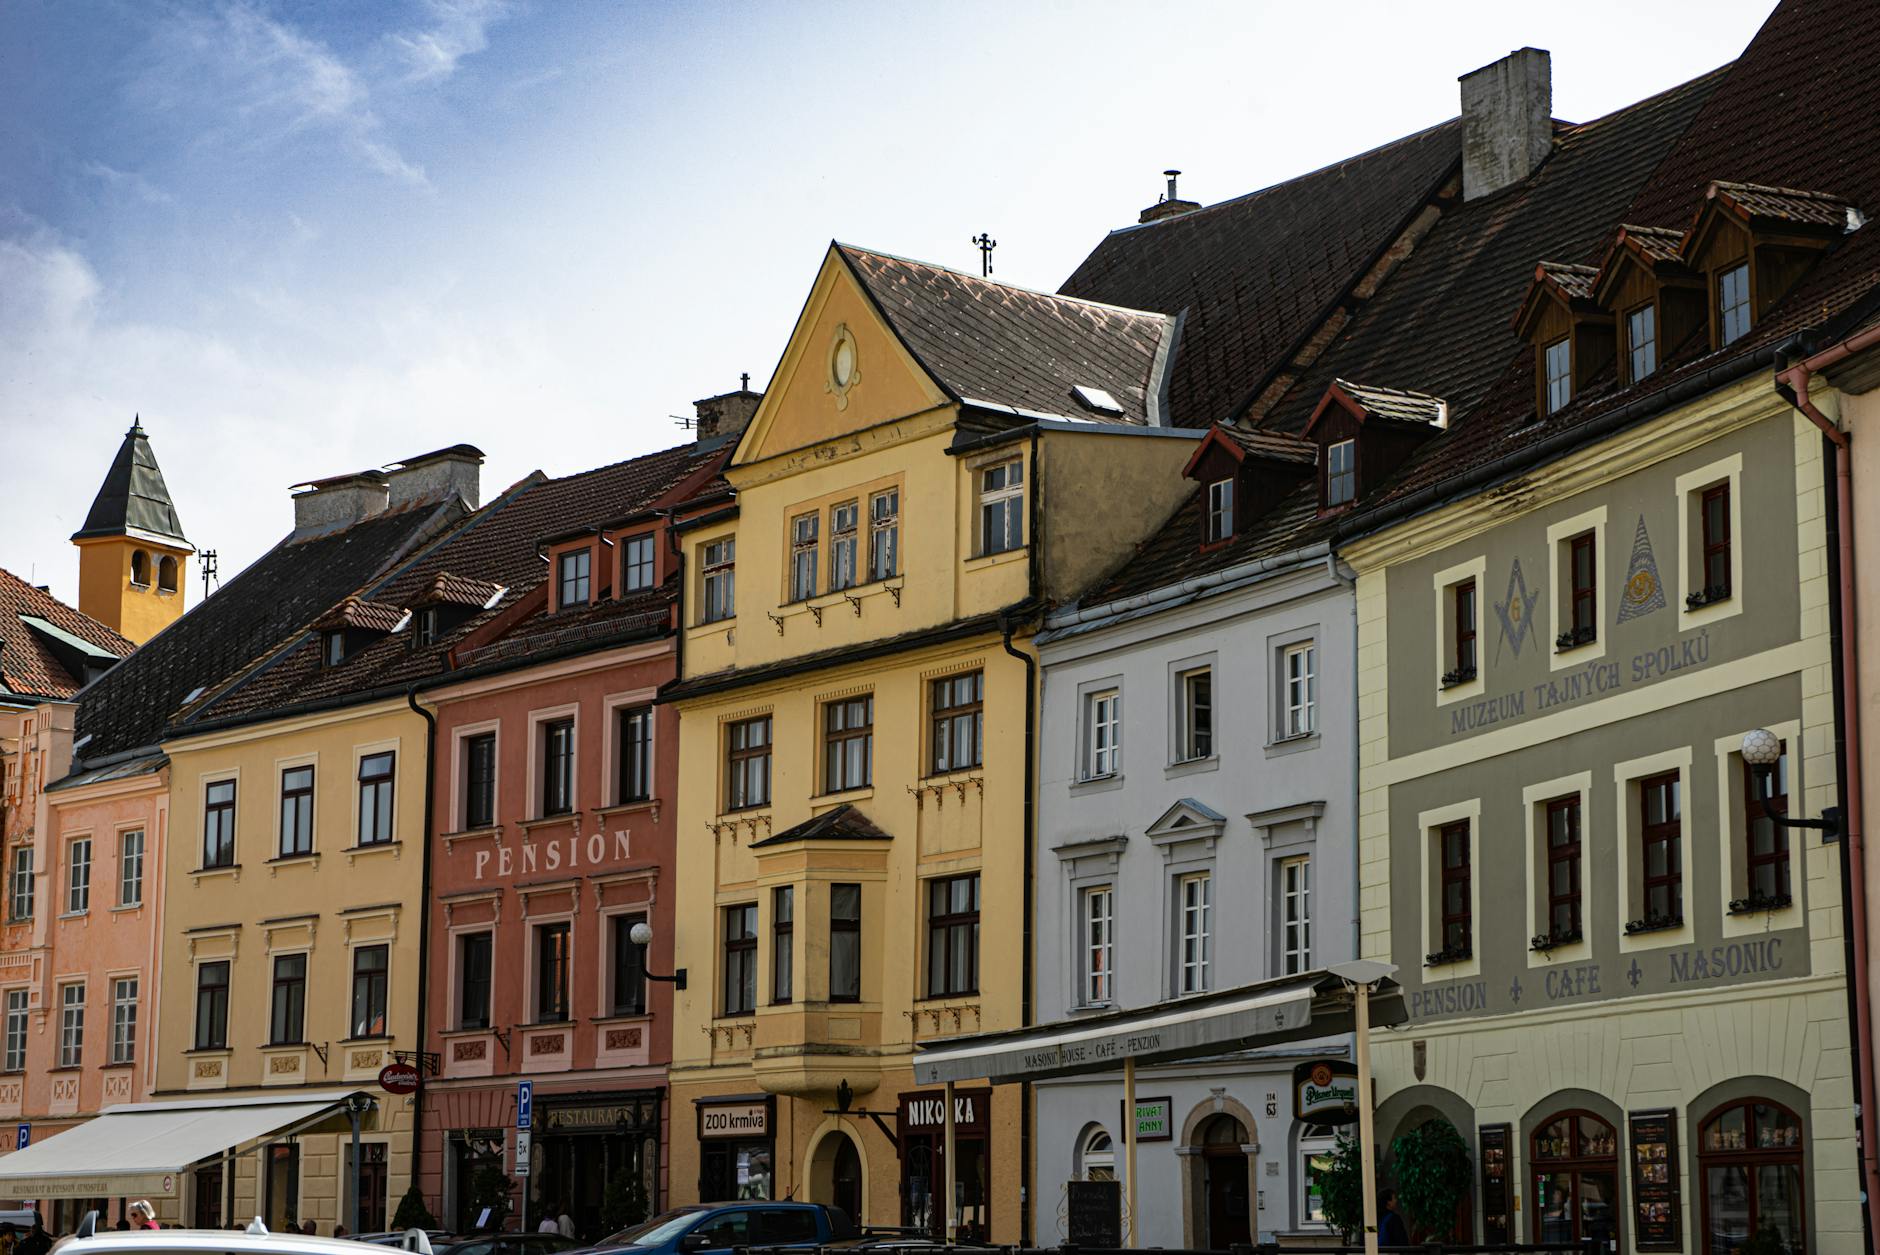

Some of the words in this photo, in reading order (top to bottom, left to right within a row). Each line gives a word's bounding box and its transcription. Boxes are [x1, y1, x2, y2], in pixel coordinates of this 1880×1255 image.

[1451, 690, 1526, 735] MUZEUM
[1534, 661, 1621, 710] TAJNÝCH
[1631, 628, 1711, 683] SPOLKŮ
[475, 829, 631, 880] PENSION
[1411, 981, 1487, 1018] PENSION
[1545, 965, 1602, 1001] CAFE
[1669, 937, 1784, 984] MASONIC
[1024, 1050, 1059, 1069] MASONIC
[1061, 1047, 1086, 1062] HOUSE
[1095, 1039, 1116, 1058] CAFÉ
[1127, 1034, 1161, 1053] PENZION
[520, 1087, 530, 1113] P
[1306, 1086, 1332, 1106] Pilsner
[706, 1113, 727, 1130] ZOO
[729, 1111, 764, 1129] krmiva
[908, 1097, 975, 1126] NIKOKA
[1135, 1104, 1164, 1118] RIVAT
[1266, 1103, 1276, 1116] 63
[19, 1129, 28, 1149] P
